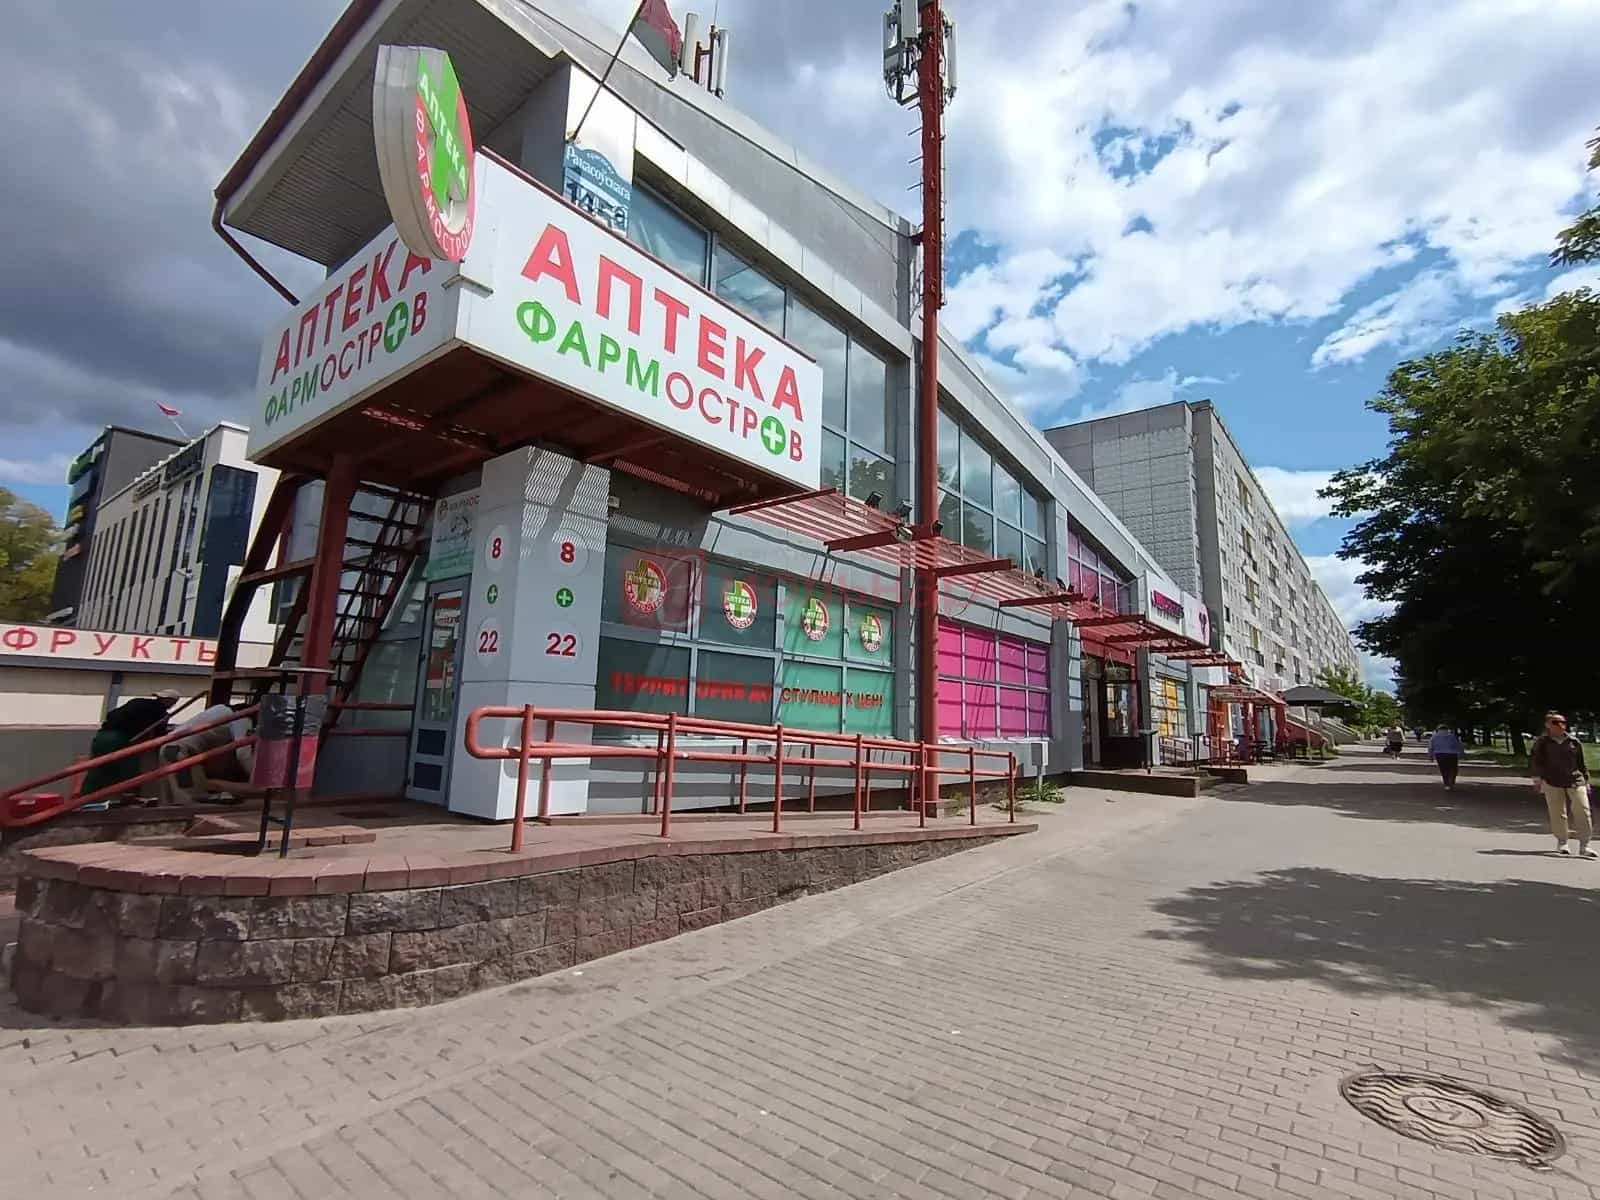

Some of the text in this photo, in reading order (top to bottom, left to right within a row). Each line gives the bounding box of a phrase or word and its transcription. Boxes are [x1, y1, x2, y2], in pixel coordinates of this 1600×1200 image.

[419, 72, 466, 189] АПТЕКА
[415, 108, 472, 257] ФАРМОСТРОВ
[270, 238, 432, 385] АПТЕКА
[521, 223, 803, 421] АПТЕКА
[492, 538, 502, 559] 8
[560, 542, 575, 563] 8
[479, 631, 498, 653] 22
[545, 633, 577, 657] 22
